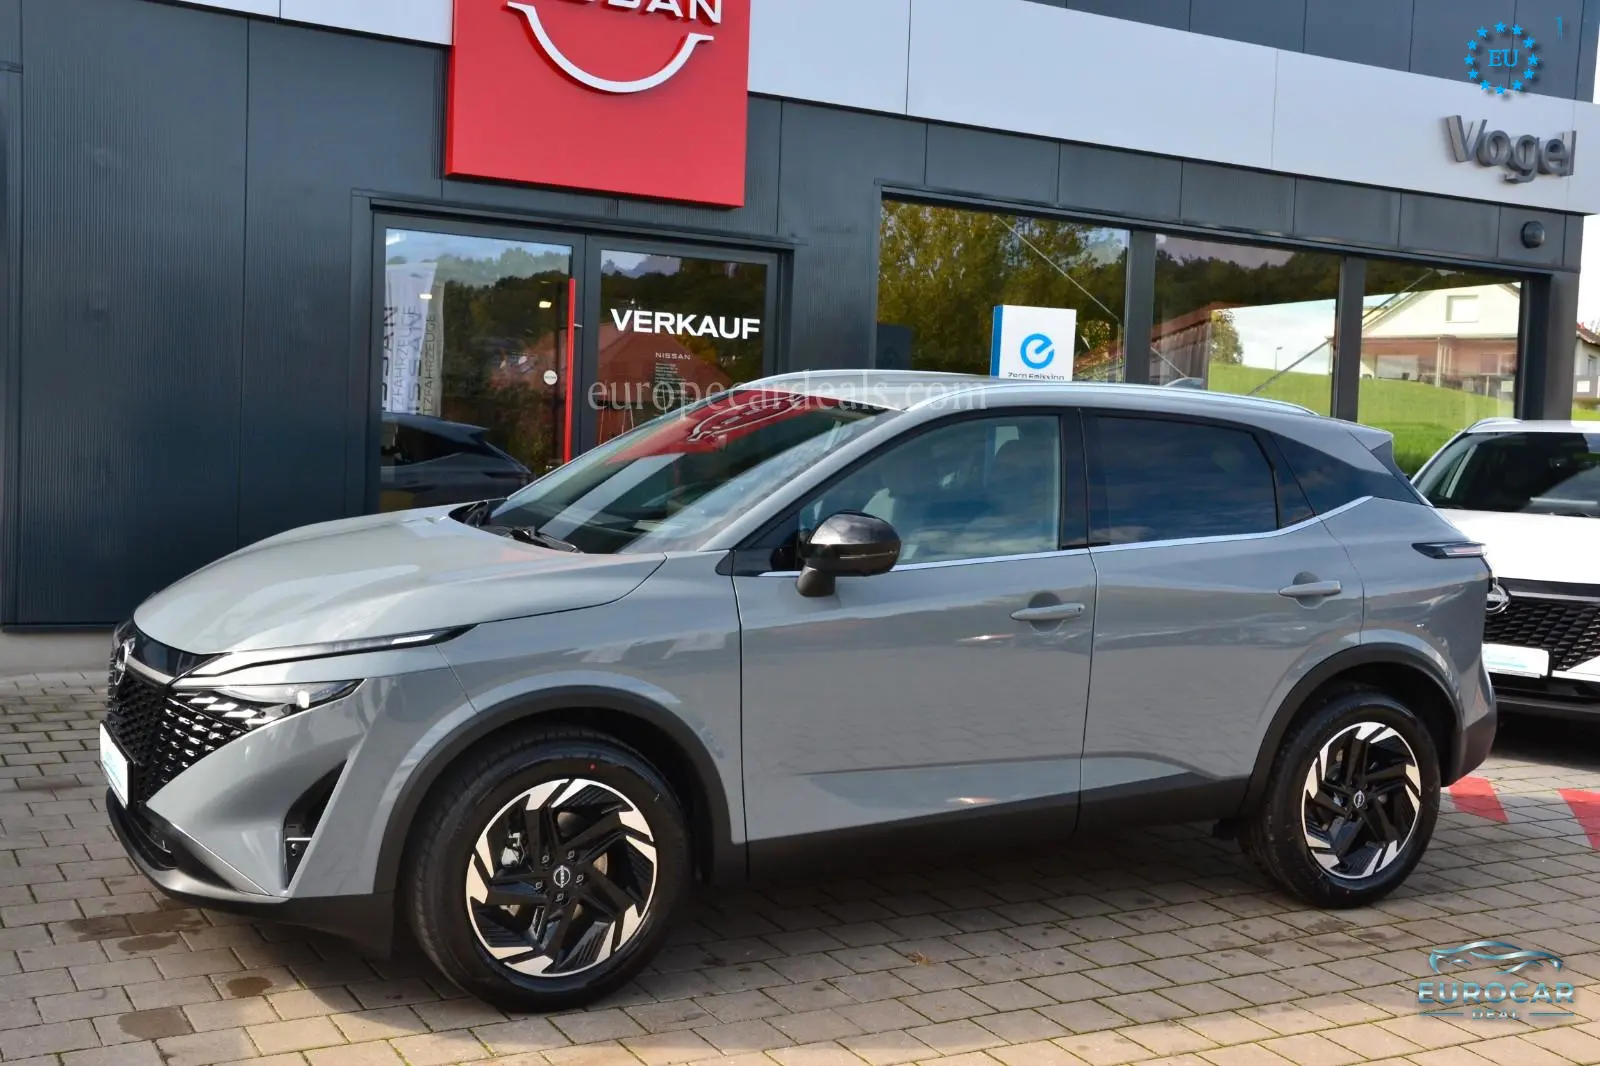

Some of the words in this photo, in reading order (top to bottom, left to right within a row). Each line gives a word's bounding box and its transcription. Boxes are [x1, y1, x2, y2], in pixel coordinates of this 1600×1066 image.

[1446, 114, 1577, 184] Vogel
[610, 308, 761, 340] VERKAUF
[655, 352, 691, 360] NISSAN
